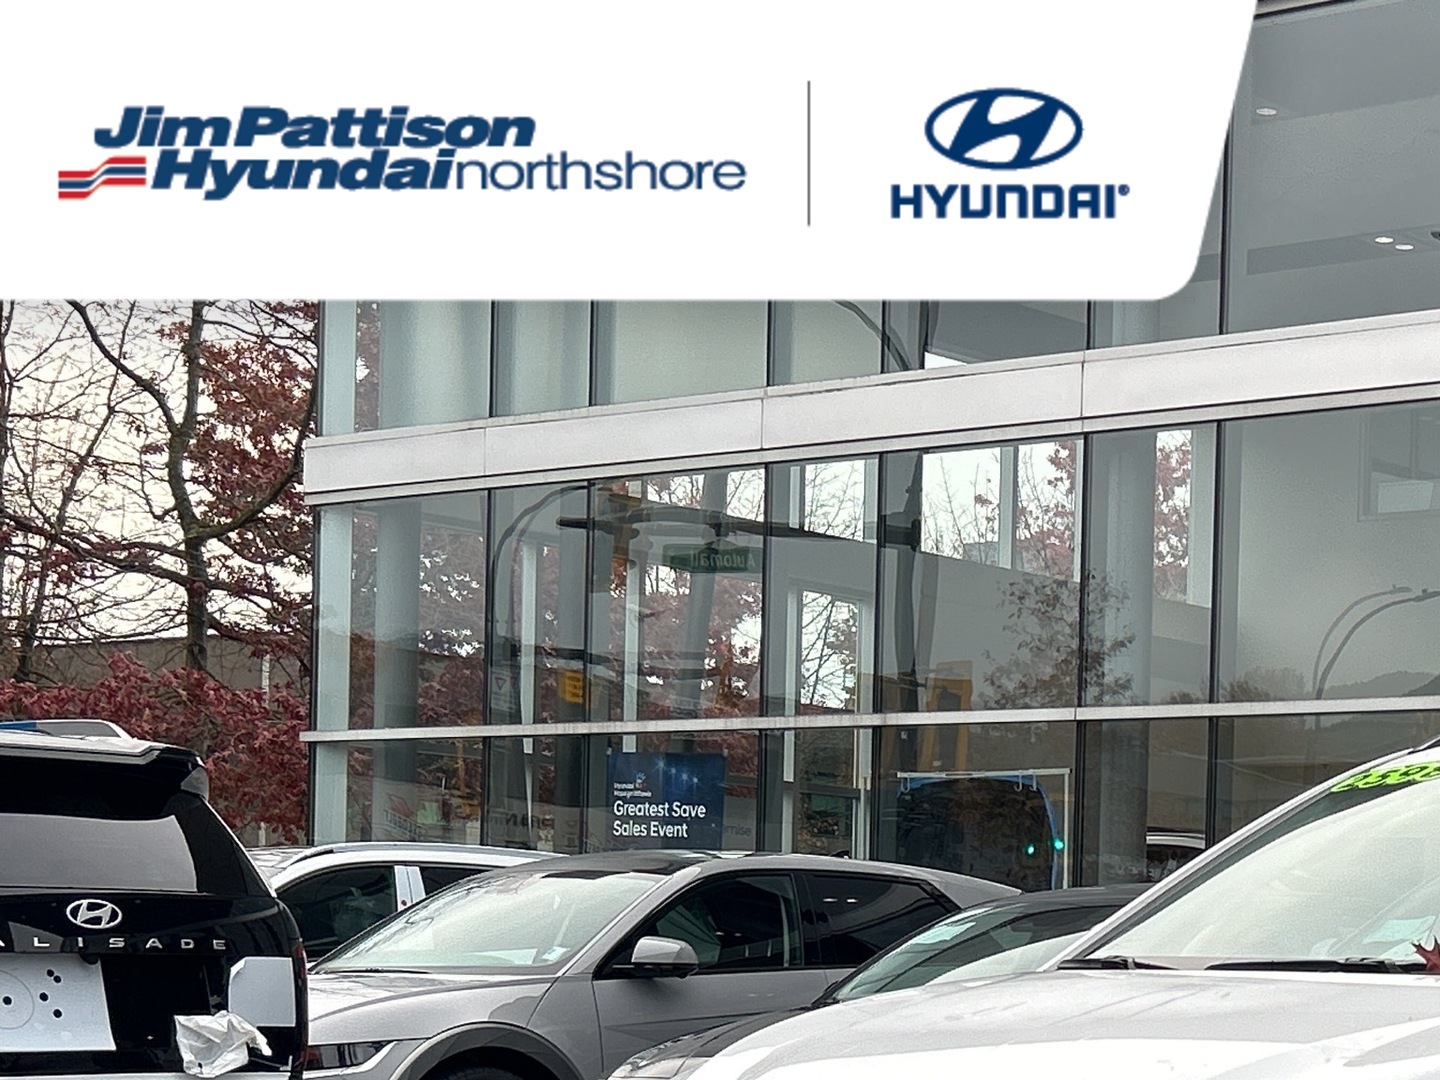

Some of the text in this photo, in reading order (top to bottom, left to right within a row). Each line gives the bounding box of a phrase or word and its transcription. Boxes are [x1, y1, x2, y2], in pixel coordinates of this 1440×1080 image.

[613, 800, 707, 818] Greatest Save
[612, 820, 688, 838] Sales Event
